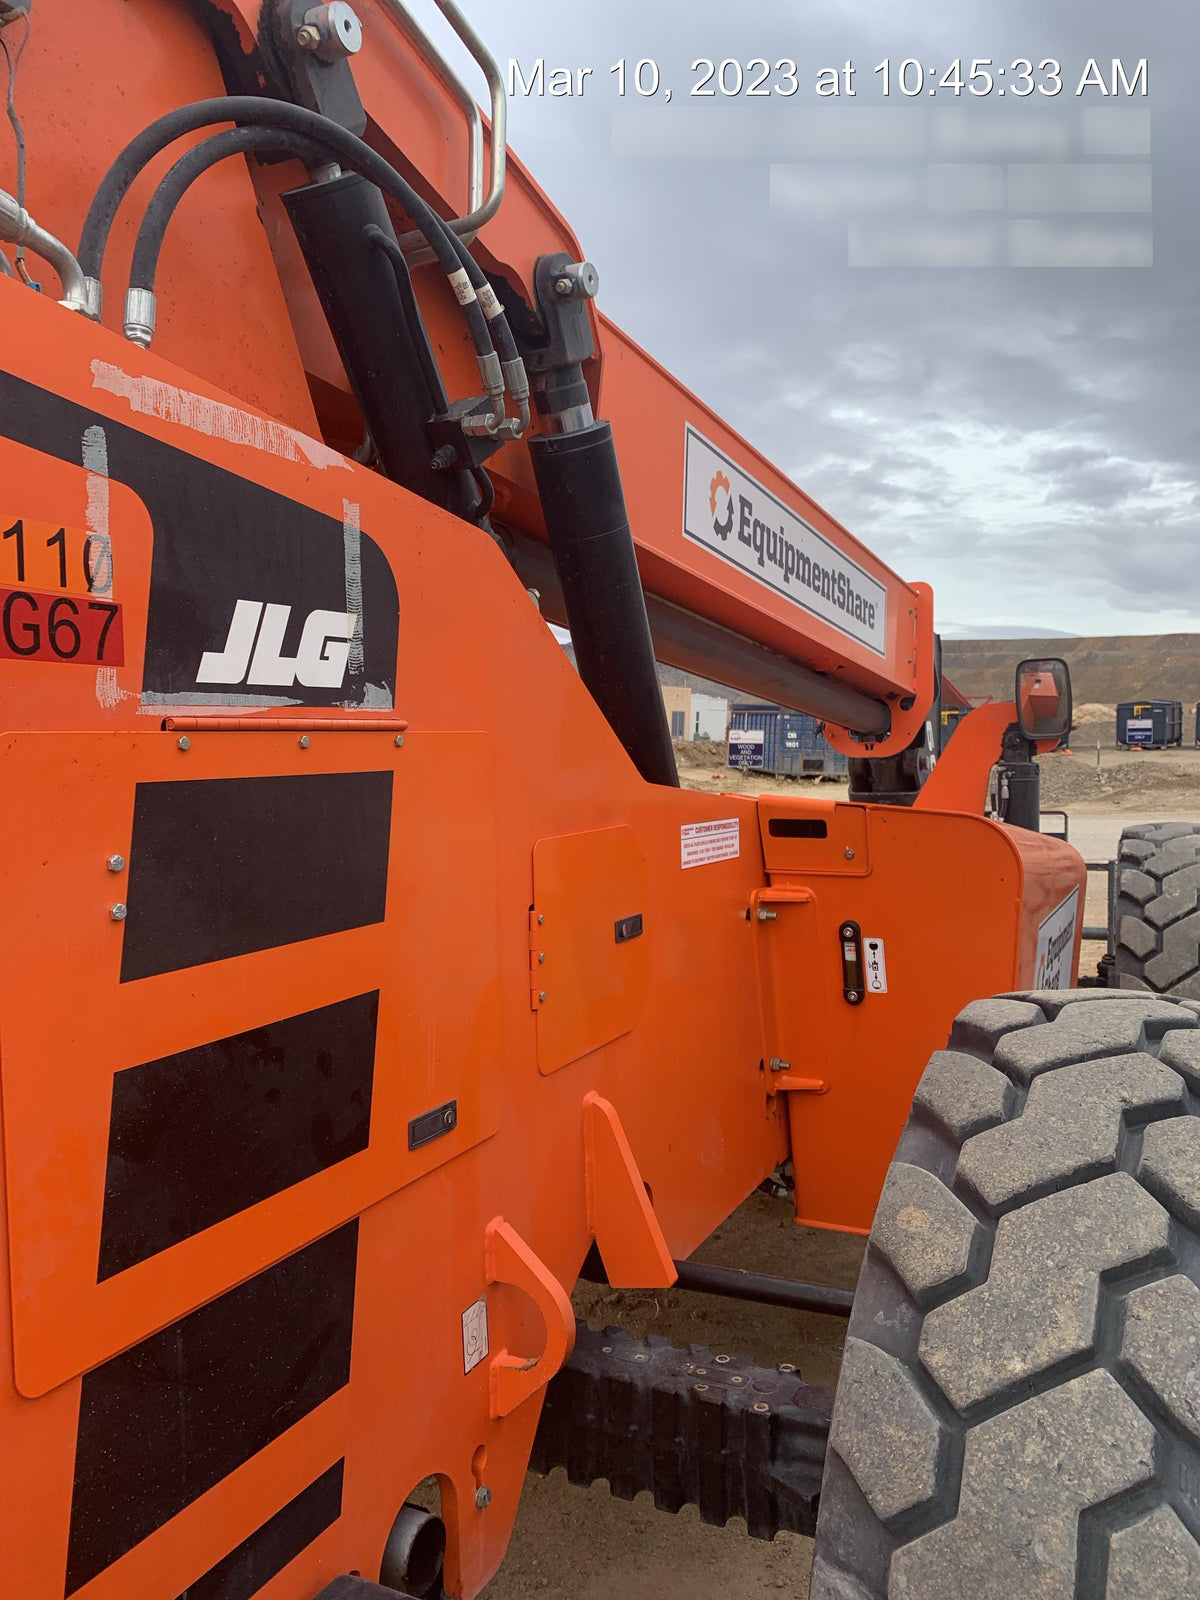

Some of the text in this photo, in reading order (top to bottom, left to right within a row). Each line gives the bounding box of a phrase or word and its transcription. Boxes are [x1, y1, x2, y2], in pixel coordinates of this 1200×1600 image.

[738, 494, 876, 630] EquipmentShare
[3, 590, 118, 661] G67
[196, 600, 357, 688] JLG
